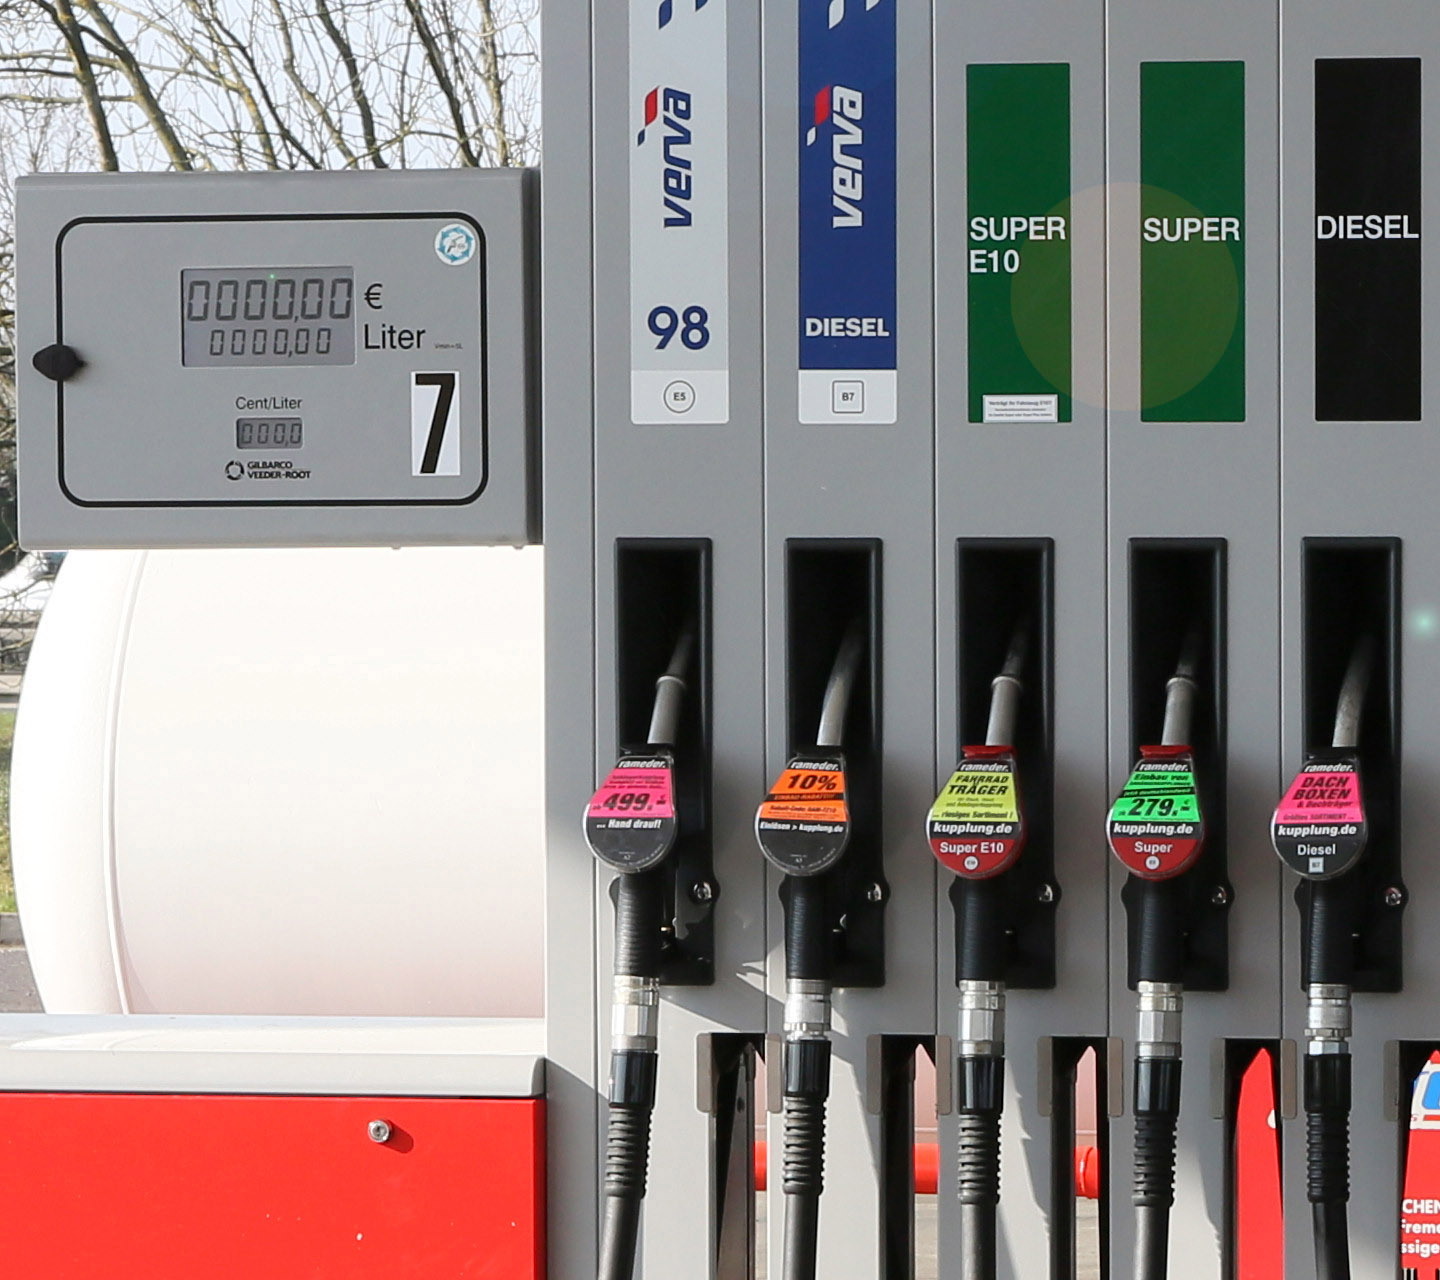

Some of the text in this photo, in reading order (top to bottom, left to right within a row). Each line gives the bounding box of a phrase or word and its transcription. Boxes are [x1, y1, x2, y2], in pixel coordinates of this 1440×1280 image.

[663, 87, 691, 227] verva
[832, 85, 862, 228] verva
[970, 217, 1066, 241] SUPER
[1143, 217, 1240, 242] SUPER
[1317, 215, 1419, 239] DIESEL
[970, 250, 1020, 273] E10
[364, 283, 383, 309] €
[647, 305, 710, 350] 98
[805, 318, 890, 337] DIESEL
[364, 323, 426, 350] Liter
[235, 396, 304, 411] Cent/Liter
[673, 392, 686, 401] E5
[842, 392, 855, 401] B7
[414, 373, 456, 475] 7
[247, 461, 293, 469] GILBARCO
[247, 471, 311, 479] VEEDER-ROOT
[788, 774, 837, 790] 10%
[955, 775, 1009, 783] FAHRRAD
[1300, 776, 1350, 788] DACH
[948, 782, 1009, 795] TRÄGER
[1292, 788, 1352, 800] BOXEN
[608, 819, 632, 828] Hand
[933, 822, 1013, 835] kupplung.de
[1113, 822, 1193, 836] kupplung.de
[1278, 824, 1357, 837] kupplung.de
[940, 841, 1004, 855] Super E10
[1134, 841, 1173, 855] Super
[1297, 844, 1336, 855] Diesel
